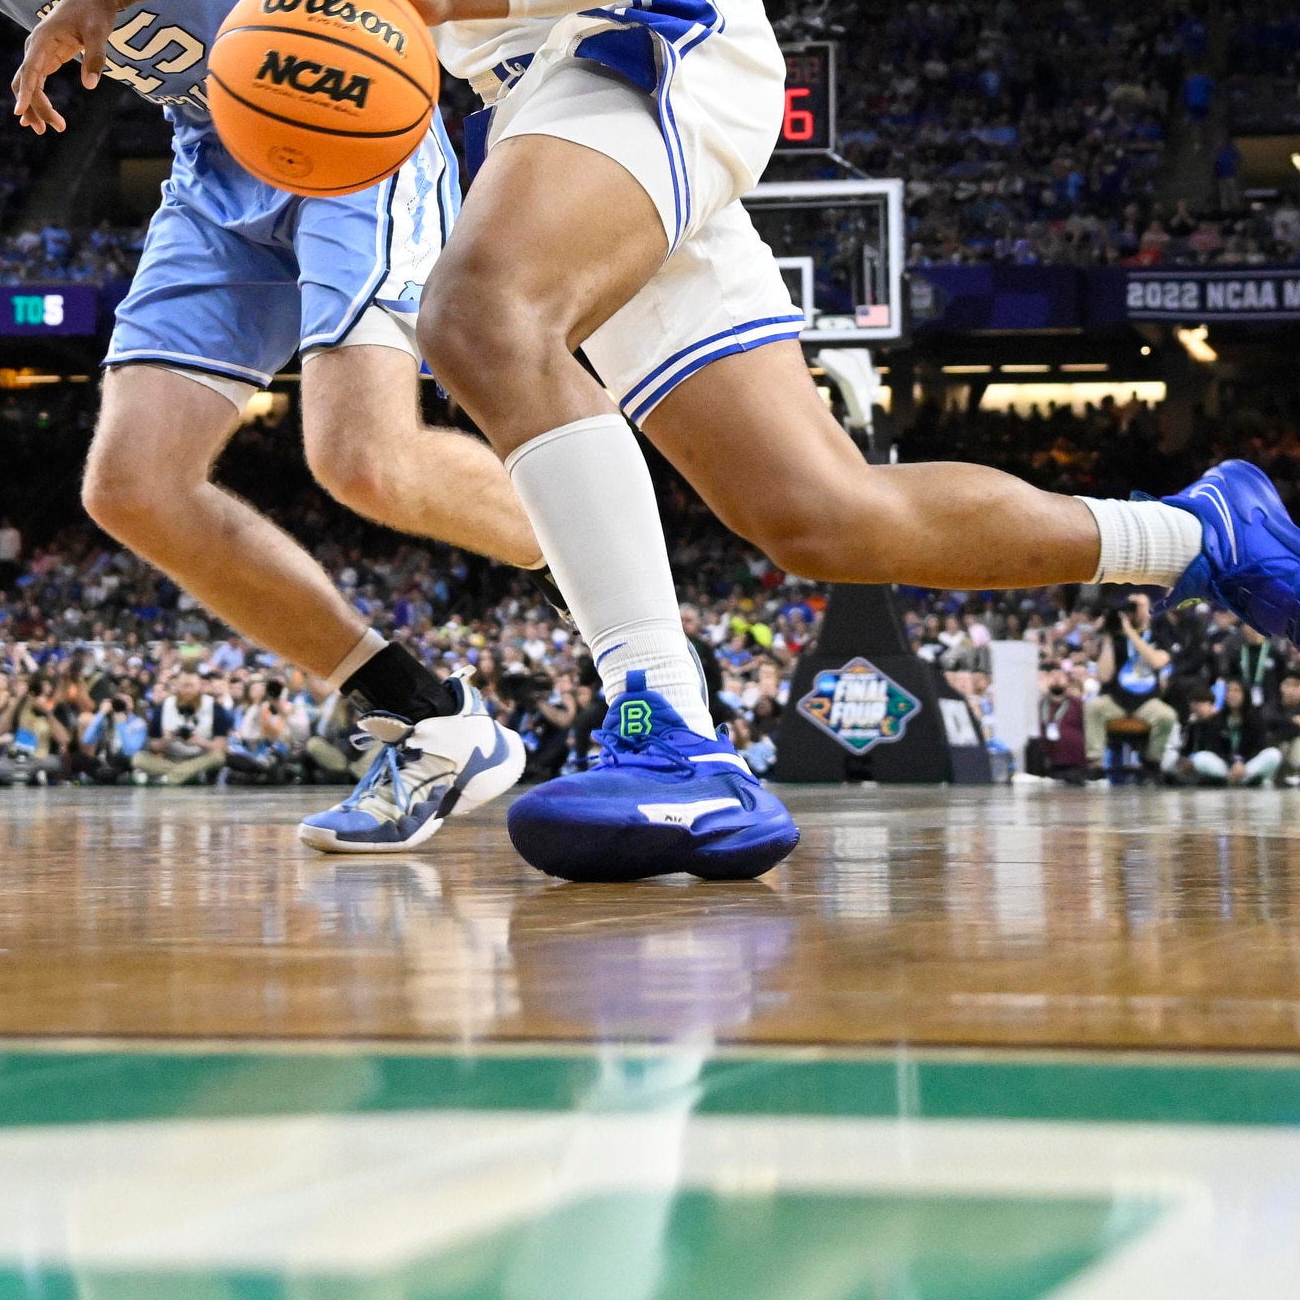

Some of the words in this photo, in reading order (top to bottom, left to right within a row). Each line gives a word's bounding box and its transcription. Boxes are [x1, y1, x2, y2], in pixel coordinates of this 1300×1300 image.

[255, 49, 372, 110] NCAA
[1127, 281, 1199, 311] 2022
[1206, 280, 1277, 310] NCAA
[620, 699, 653, 738] B
